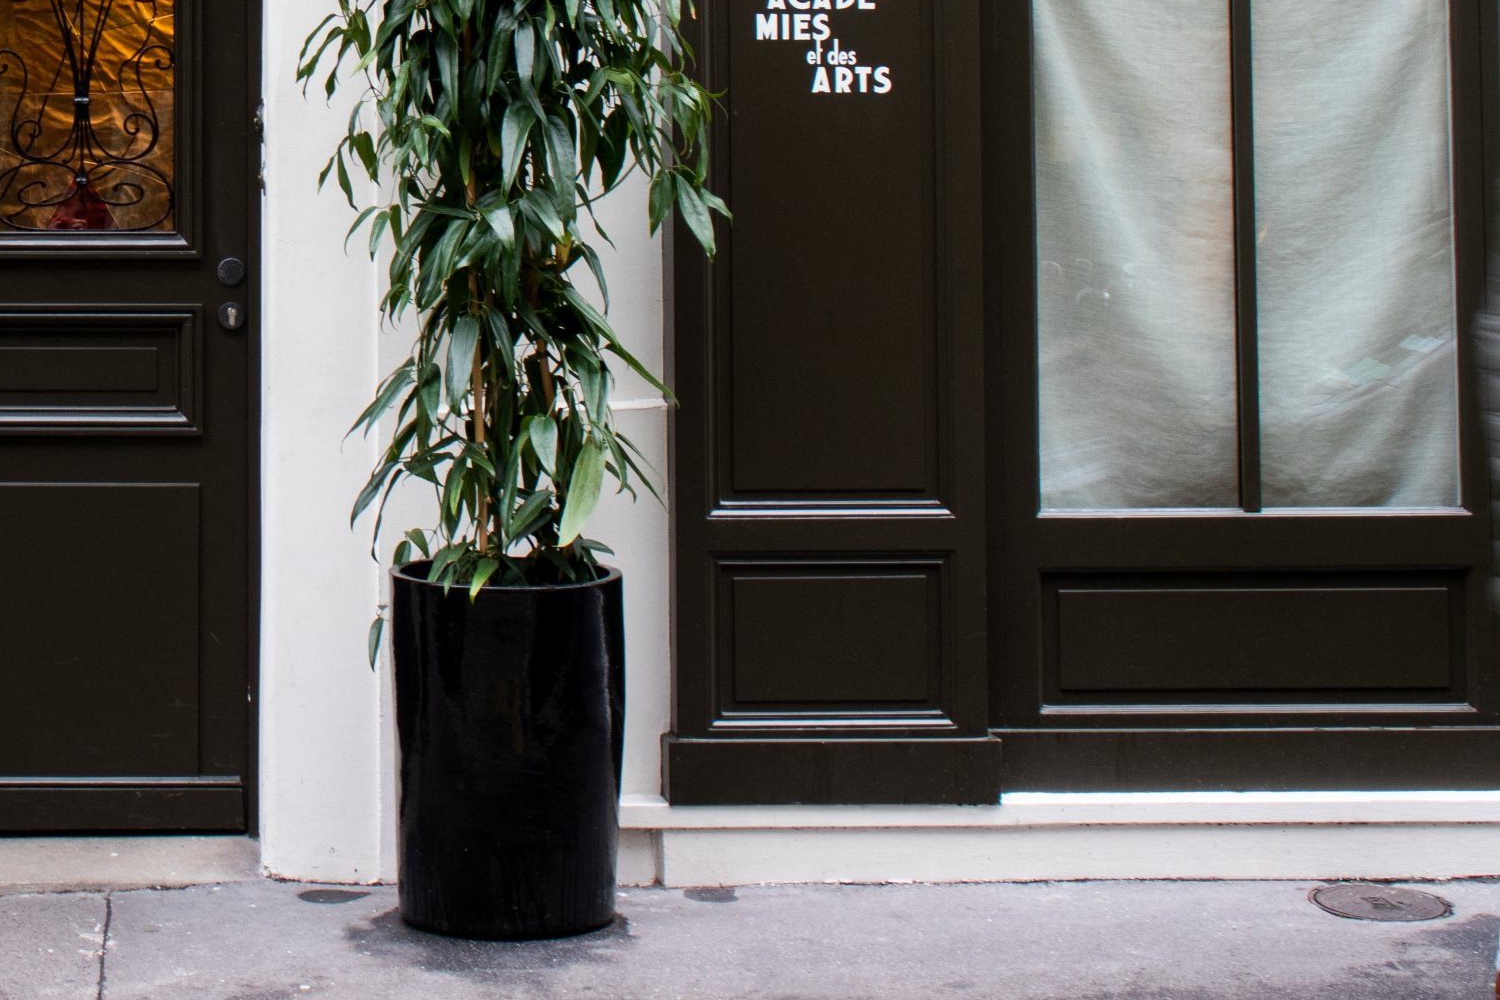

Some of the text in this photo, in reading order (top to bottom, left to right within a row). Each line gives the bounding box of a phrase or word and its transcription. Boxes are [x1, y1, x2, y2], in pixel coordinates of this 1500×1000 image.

[755, 13, 831, 41] MIES
[806, 39, 857, 66] et des
[811, 66, 892, 94] ARTS
